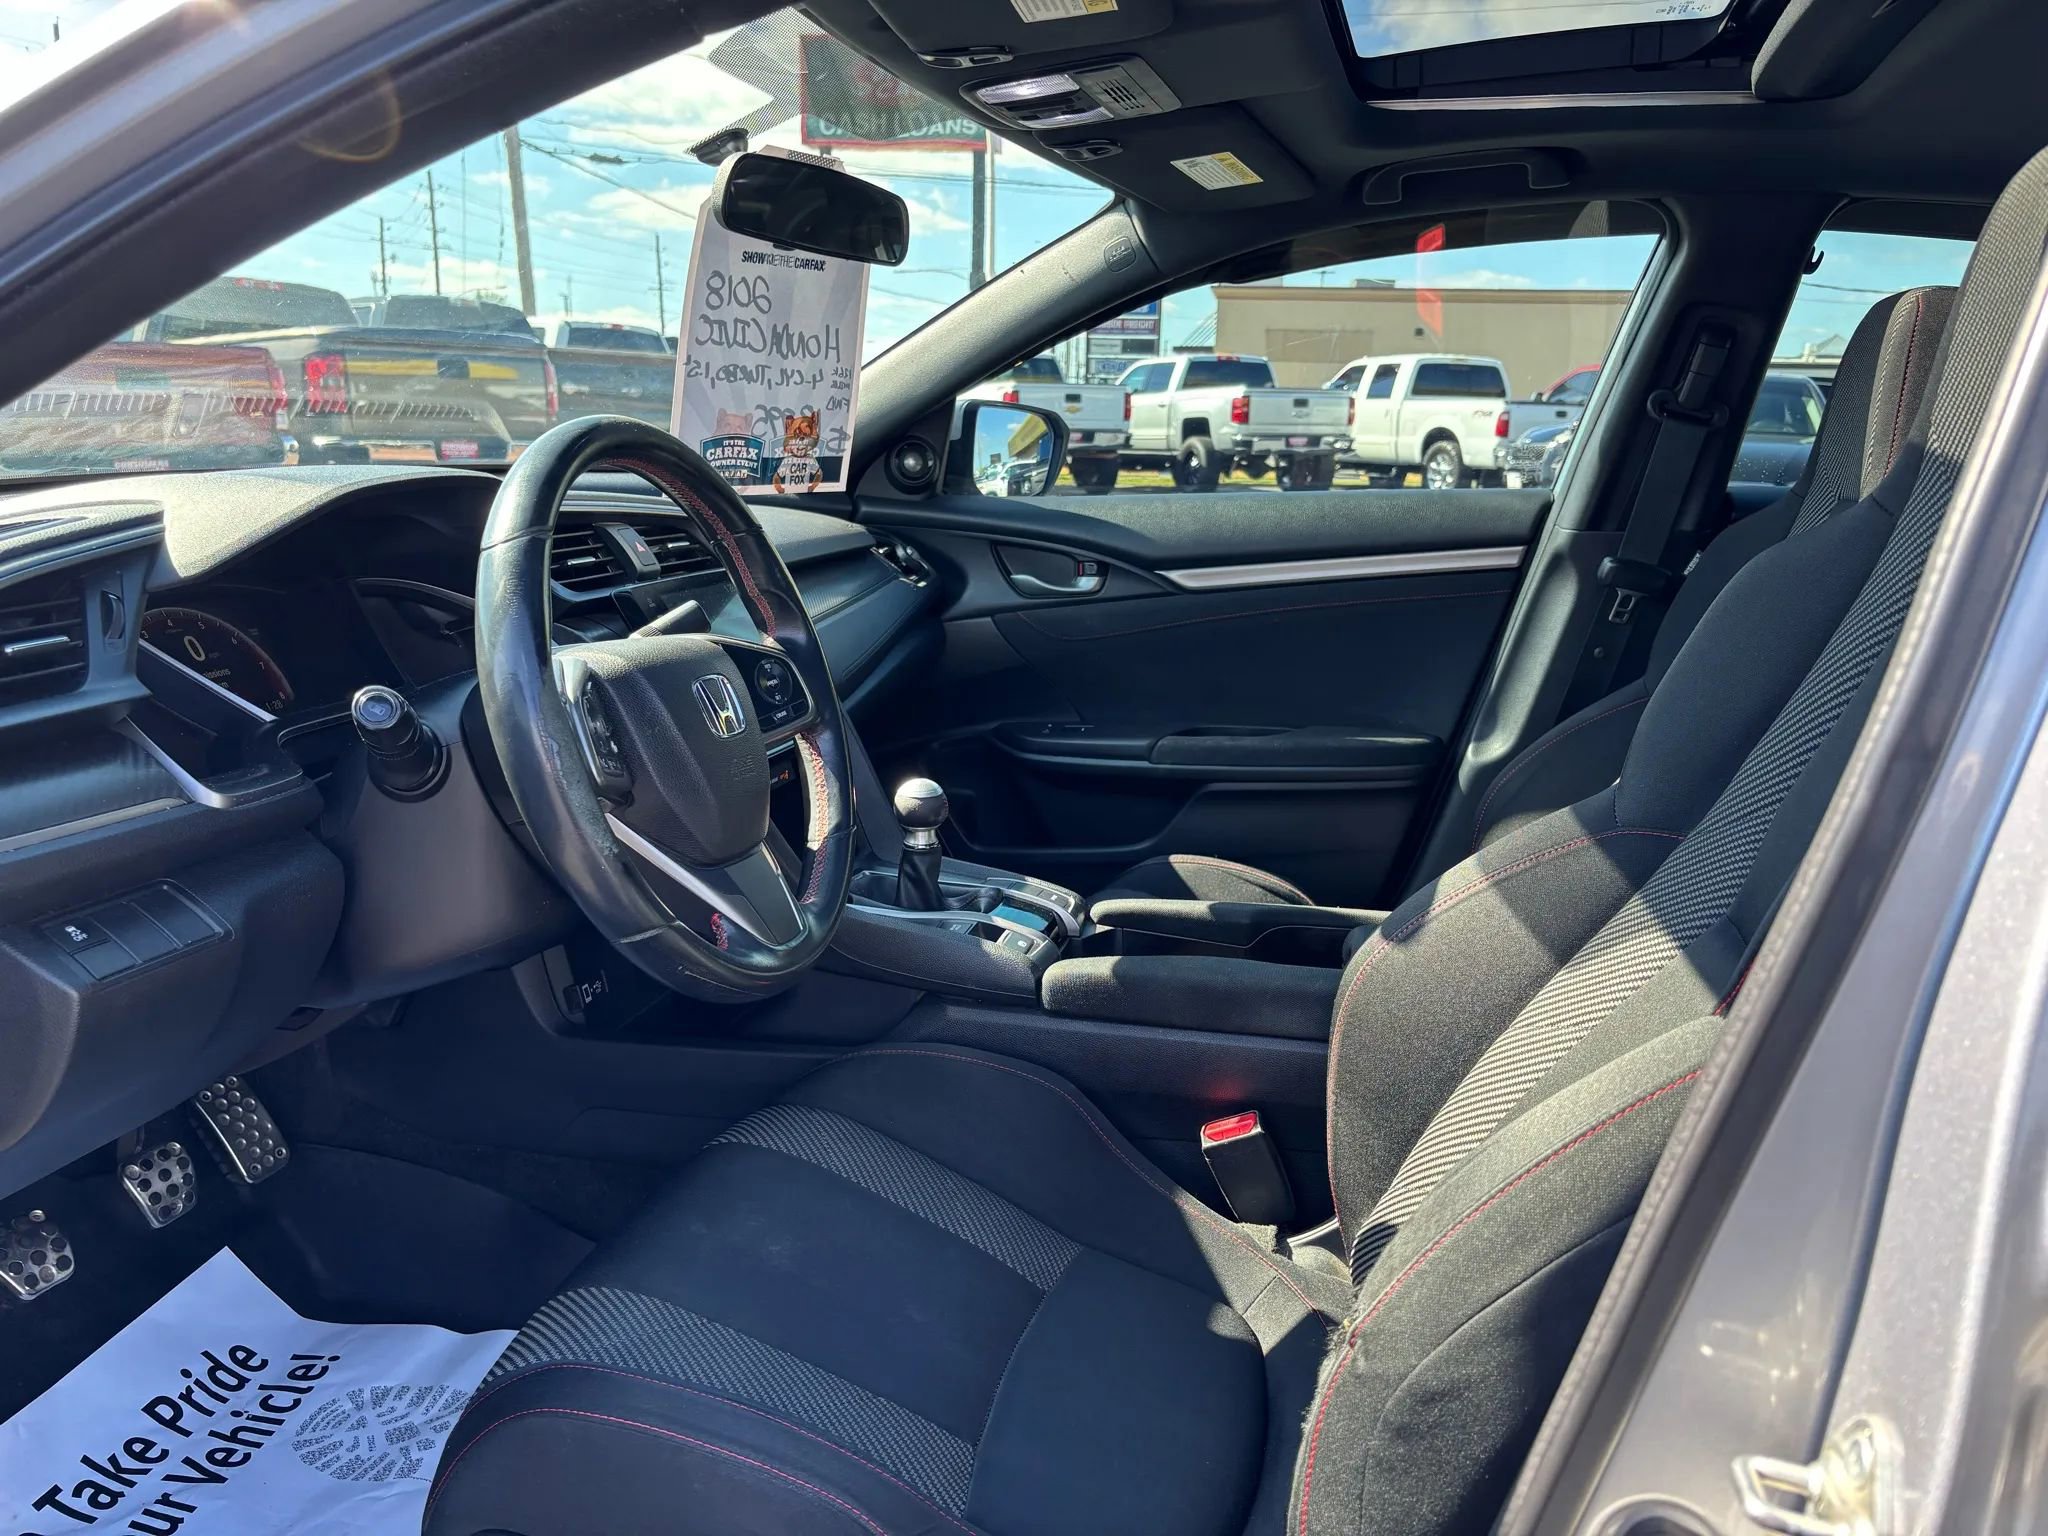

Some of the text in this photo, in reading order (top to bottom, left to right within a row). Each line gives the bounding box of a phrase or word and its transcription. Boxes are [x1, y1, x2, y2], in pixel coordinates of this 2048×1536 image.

[818, 111, 978, 138] CASH LOANS
[706, 446, 758, 461] CARFAX
[710, 459, 758, 469] OWNER EVENT
[790, 463, 808, 474] CAR
[789, 475, 805, 486] FOX
[198, 621, 205, 630] 5
[183, 635, 206, 662] 0
[161, 1353, 341, 1485] Vehicle!
[31, 1344, 269, 1525] Take Pride
